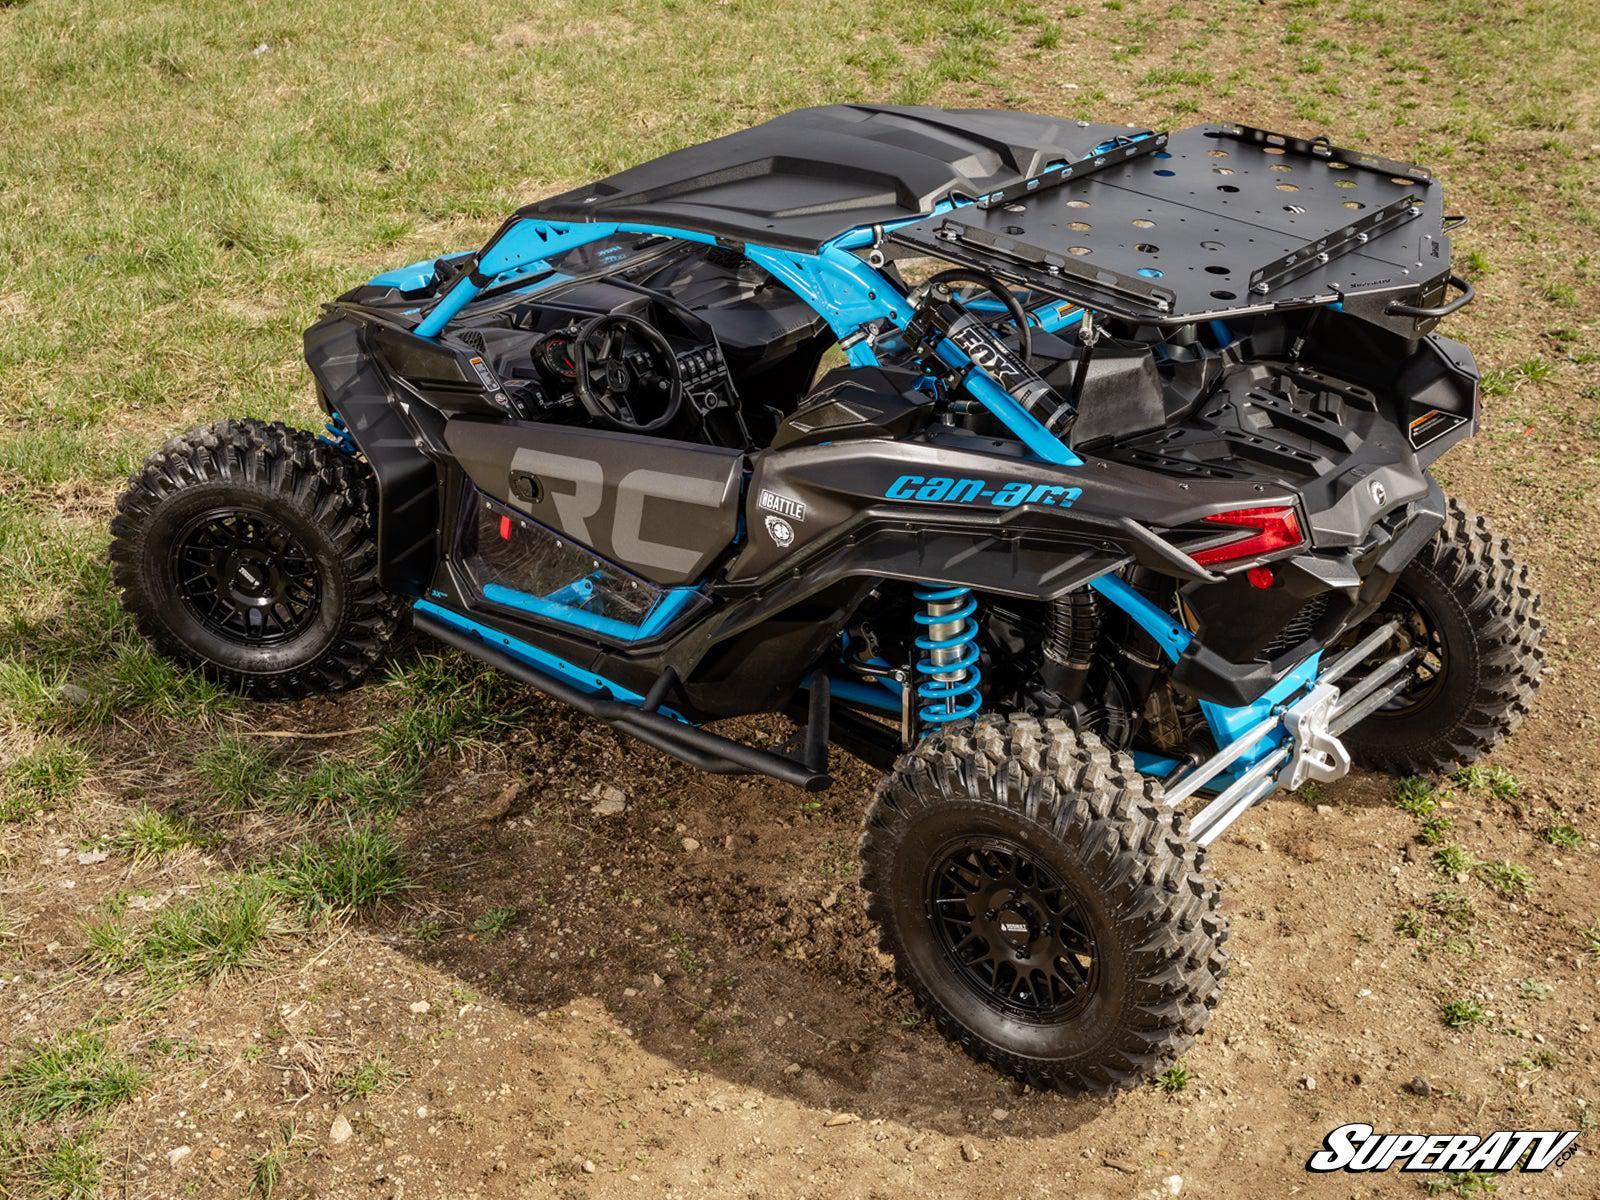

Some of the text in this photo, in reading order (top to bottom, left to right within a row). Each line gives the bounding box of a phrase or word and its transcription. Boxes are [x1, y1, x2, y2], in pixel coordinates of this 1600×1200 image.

[953, 328, 1018, 380] FOX
[508, 447, 726, 573] RC
[884, 475, 1083, 508] can-am
